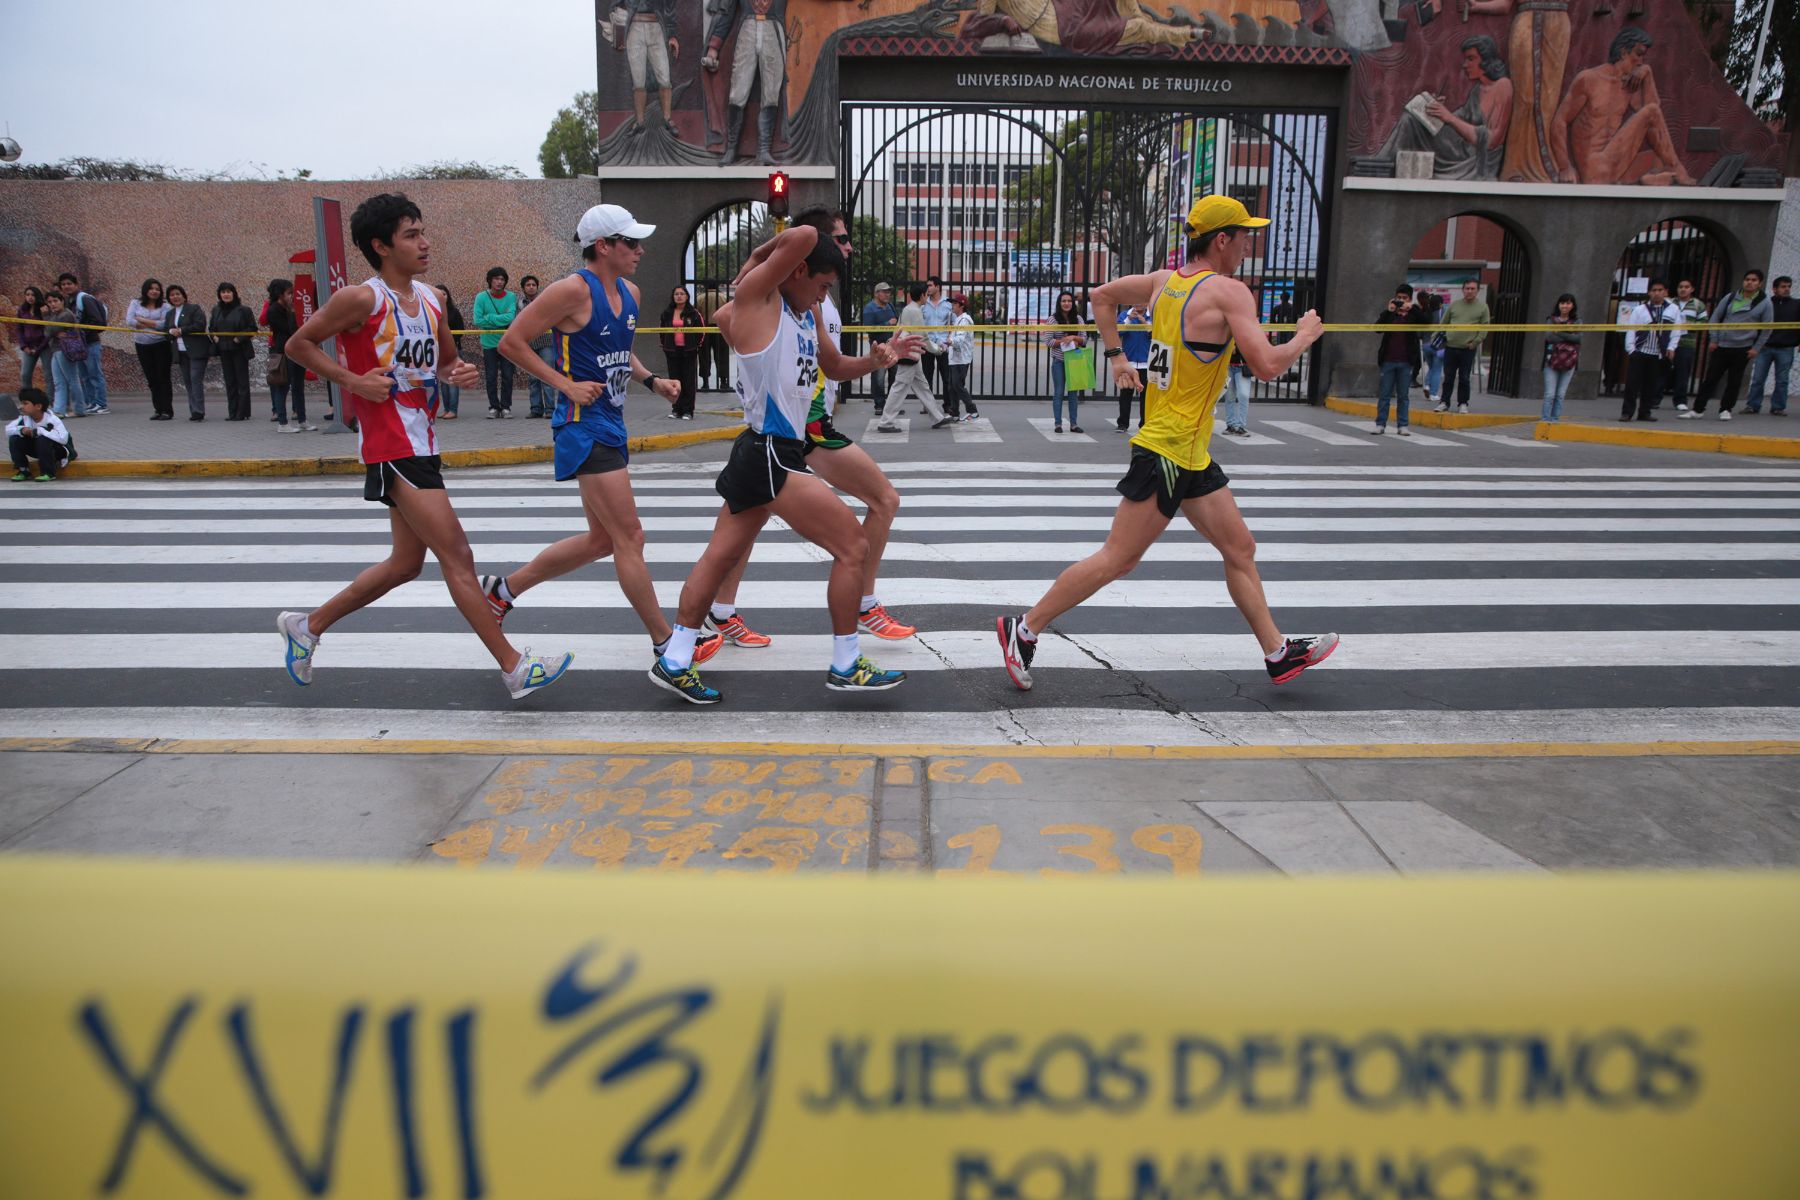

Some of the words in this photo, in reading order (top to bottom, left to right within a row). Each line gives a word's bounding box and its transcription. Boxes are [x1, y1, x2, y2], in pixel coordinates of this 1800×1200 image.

[956, 73, 1054, 87] UNIVERSIDAD
[1058, 75, 1135, 90] NACIONAL
[1142, 77, 1160, 90] DE
[1166, 77, 1232, 93] TRUJILLO
[406, 325, 424, 333] VEN
[396, 338, 435, 368] 406
[1149, 343, 1169, 378] 24
[800, 1032, 1152, 1113] JUEGOS
[1170, 1028, 1702, 1112] DEPORTIVOS
[76, 994, 484, 1200] XVII
